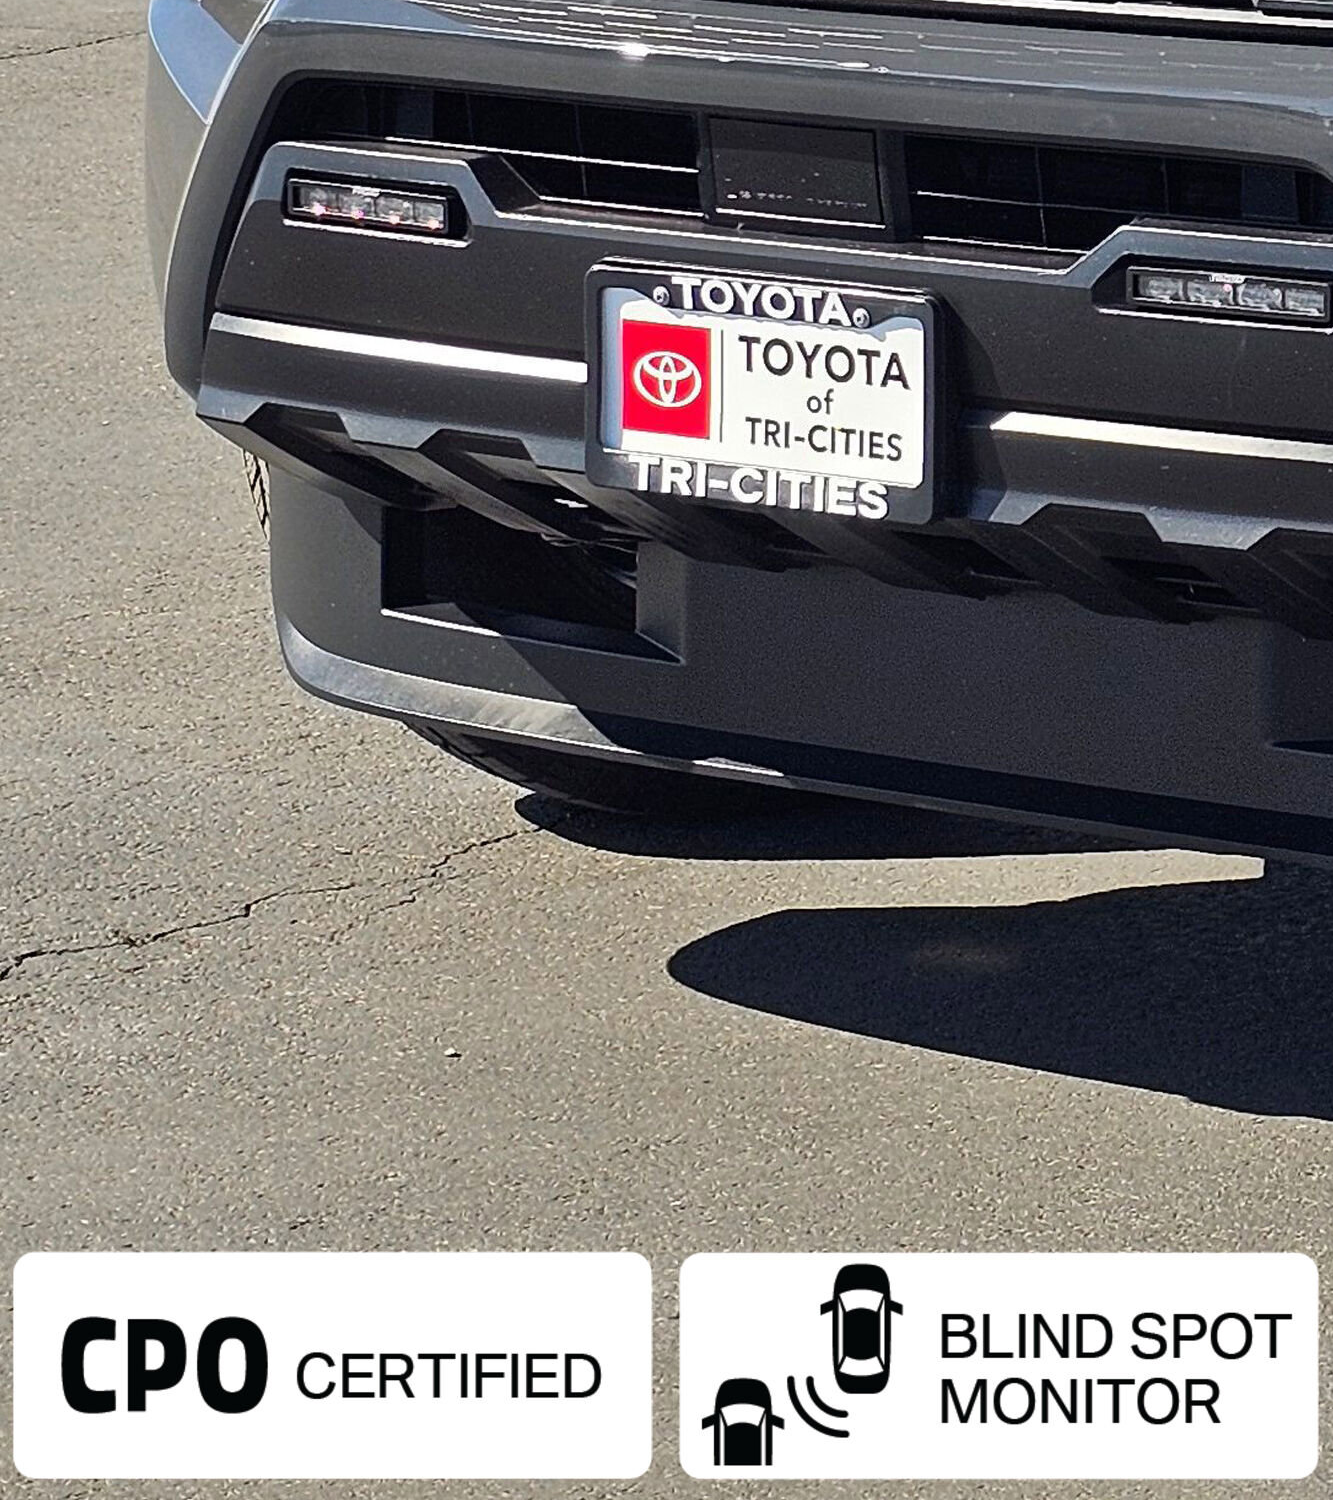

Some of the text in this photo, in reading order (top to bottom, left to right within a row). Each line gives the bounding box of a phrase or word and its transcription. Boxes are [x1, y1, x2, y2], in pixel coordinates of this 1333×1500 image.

[671, 275, 853, 328] TOYOTA
[738, 335, 911, 391] TOYOTA
[806, 388, 835, 415] of
[745, 417, 903, 462] TRI-CITIES
[629, 455, 890, 520] TRI-CITIES
